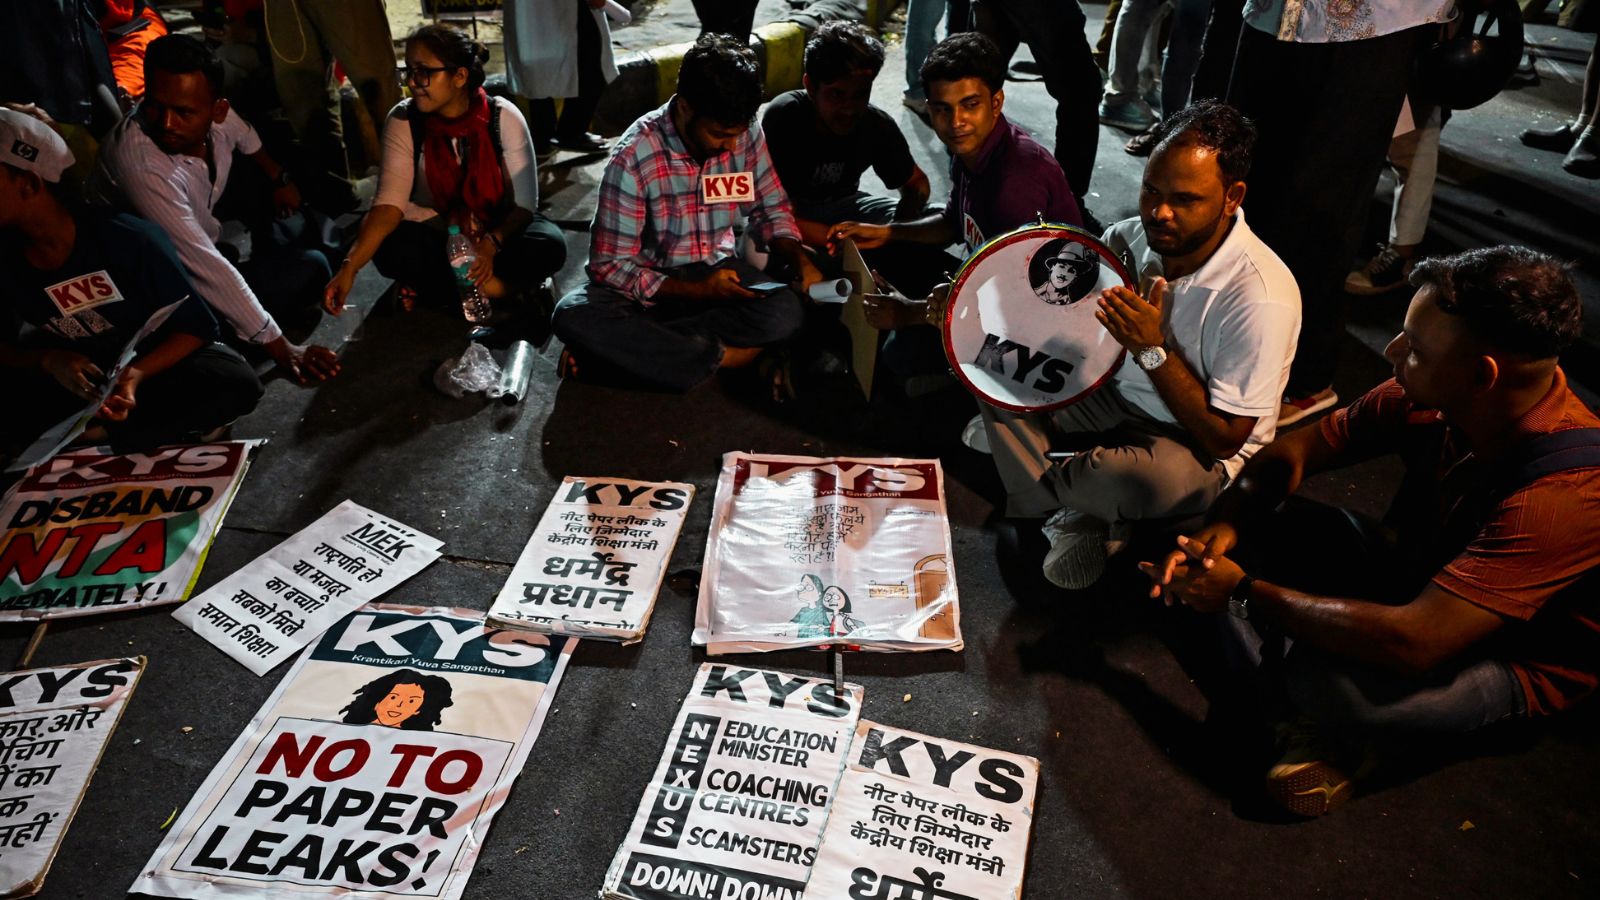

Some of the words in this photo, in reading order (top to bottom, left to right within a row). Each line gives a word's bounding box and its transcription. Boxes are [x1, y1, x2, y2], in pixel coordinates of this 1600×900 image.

[705, 176, 749, 197] KYS
[51, 276, 113, 309] KYS
[974, 333, 1074, 394] KYS
[7, 486, 214, 529] DISBAND
[563, 482, 687, 511] KYS
[846, 490, 901, 498] Sangathan
[560, 511, 586, 523] नीट
[587, 513, 614, 525] पेपर
[616, 516, 650, 527] लीक
[652, 517, 668, 528] के
[565, 523, 592, 535] लिए
[595, 524, 653, 538] जिम्मेदार
[0, 518, 167, 586] NTA
[351, 522, 414, 560] MEK
[547, 532, 586, 546] केंद्रीय
[590, 537, 629, 550] शिक्षा
[630, 539, 659, 551] मंत्री
[293, 560, 311, 577] या
[309, 567, 352, 602] मजदूर
[314, 542, 367, 575] राष्ट्रपति
[357, 568, 383, 583] हो
[543, 552, 638, 587] धर्मेंद्र
[231, 589, 278, 619] सबको
[267, 610, 305, 637] मिले
[266, 576, 286, 595] का
[284, 587, 324, 614] बच्चा!
[519, 582, 634, 612] प्रधान
[198, 603, 241, 633] समान
[232, 624, 279, 659] शिक्षा!
[334, 615, 551, 668] KYS
[352, 654, 408, 665] Krantikari
[410, 657, 439, 669] Yuva
[441, 662, 506, 675] Sangathan
[700, 666, 853, 718] KYS
[48, 705, 105, 733] और
[723, 720, 838, 753] EDUCATION
[256, 732, 371, 783] NO
[387, 743, 484, 796] TO
[717, 739, 810, 768] MINISTER
[858, 728, 1025, 804] KYS
[14, 764, 62, 788] का
[654, 722, 711, 838] NEXUS
[706, 769, 829, 807] COACHING
[234, 780, 459, 840] PAPER
[699, 791, 810, 827] CENTRES
[863, 783, 898, 804] नीट
[900, 790, 938, 815] पेपर
[942, 803, 988, 827] लीक
[990, 813, 1012, 834] के
[687, 827, 817, 867] SCAMSTERS
[871, 805, 911, 831] लिए
[914, 815, 994, 851] जिम्मेदार
[190, 826, 441, 892] LEAKS!
[850, 821, 907, 850] केंद्रीय
[909, 835, 963, 866] शिक्षा
[966, 852, 1006, 877] मंत्री
[630, 862, 719, 900] DOWN!
